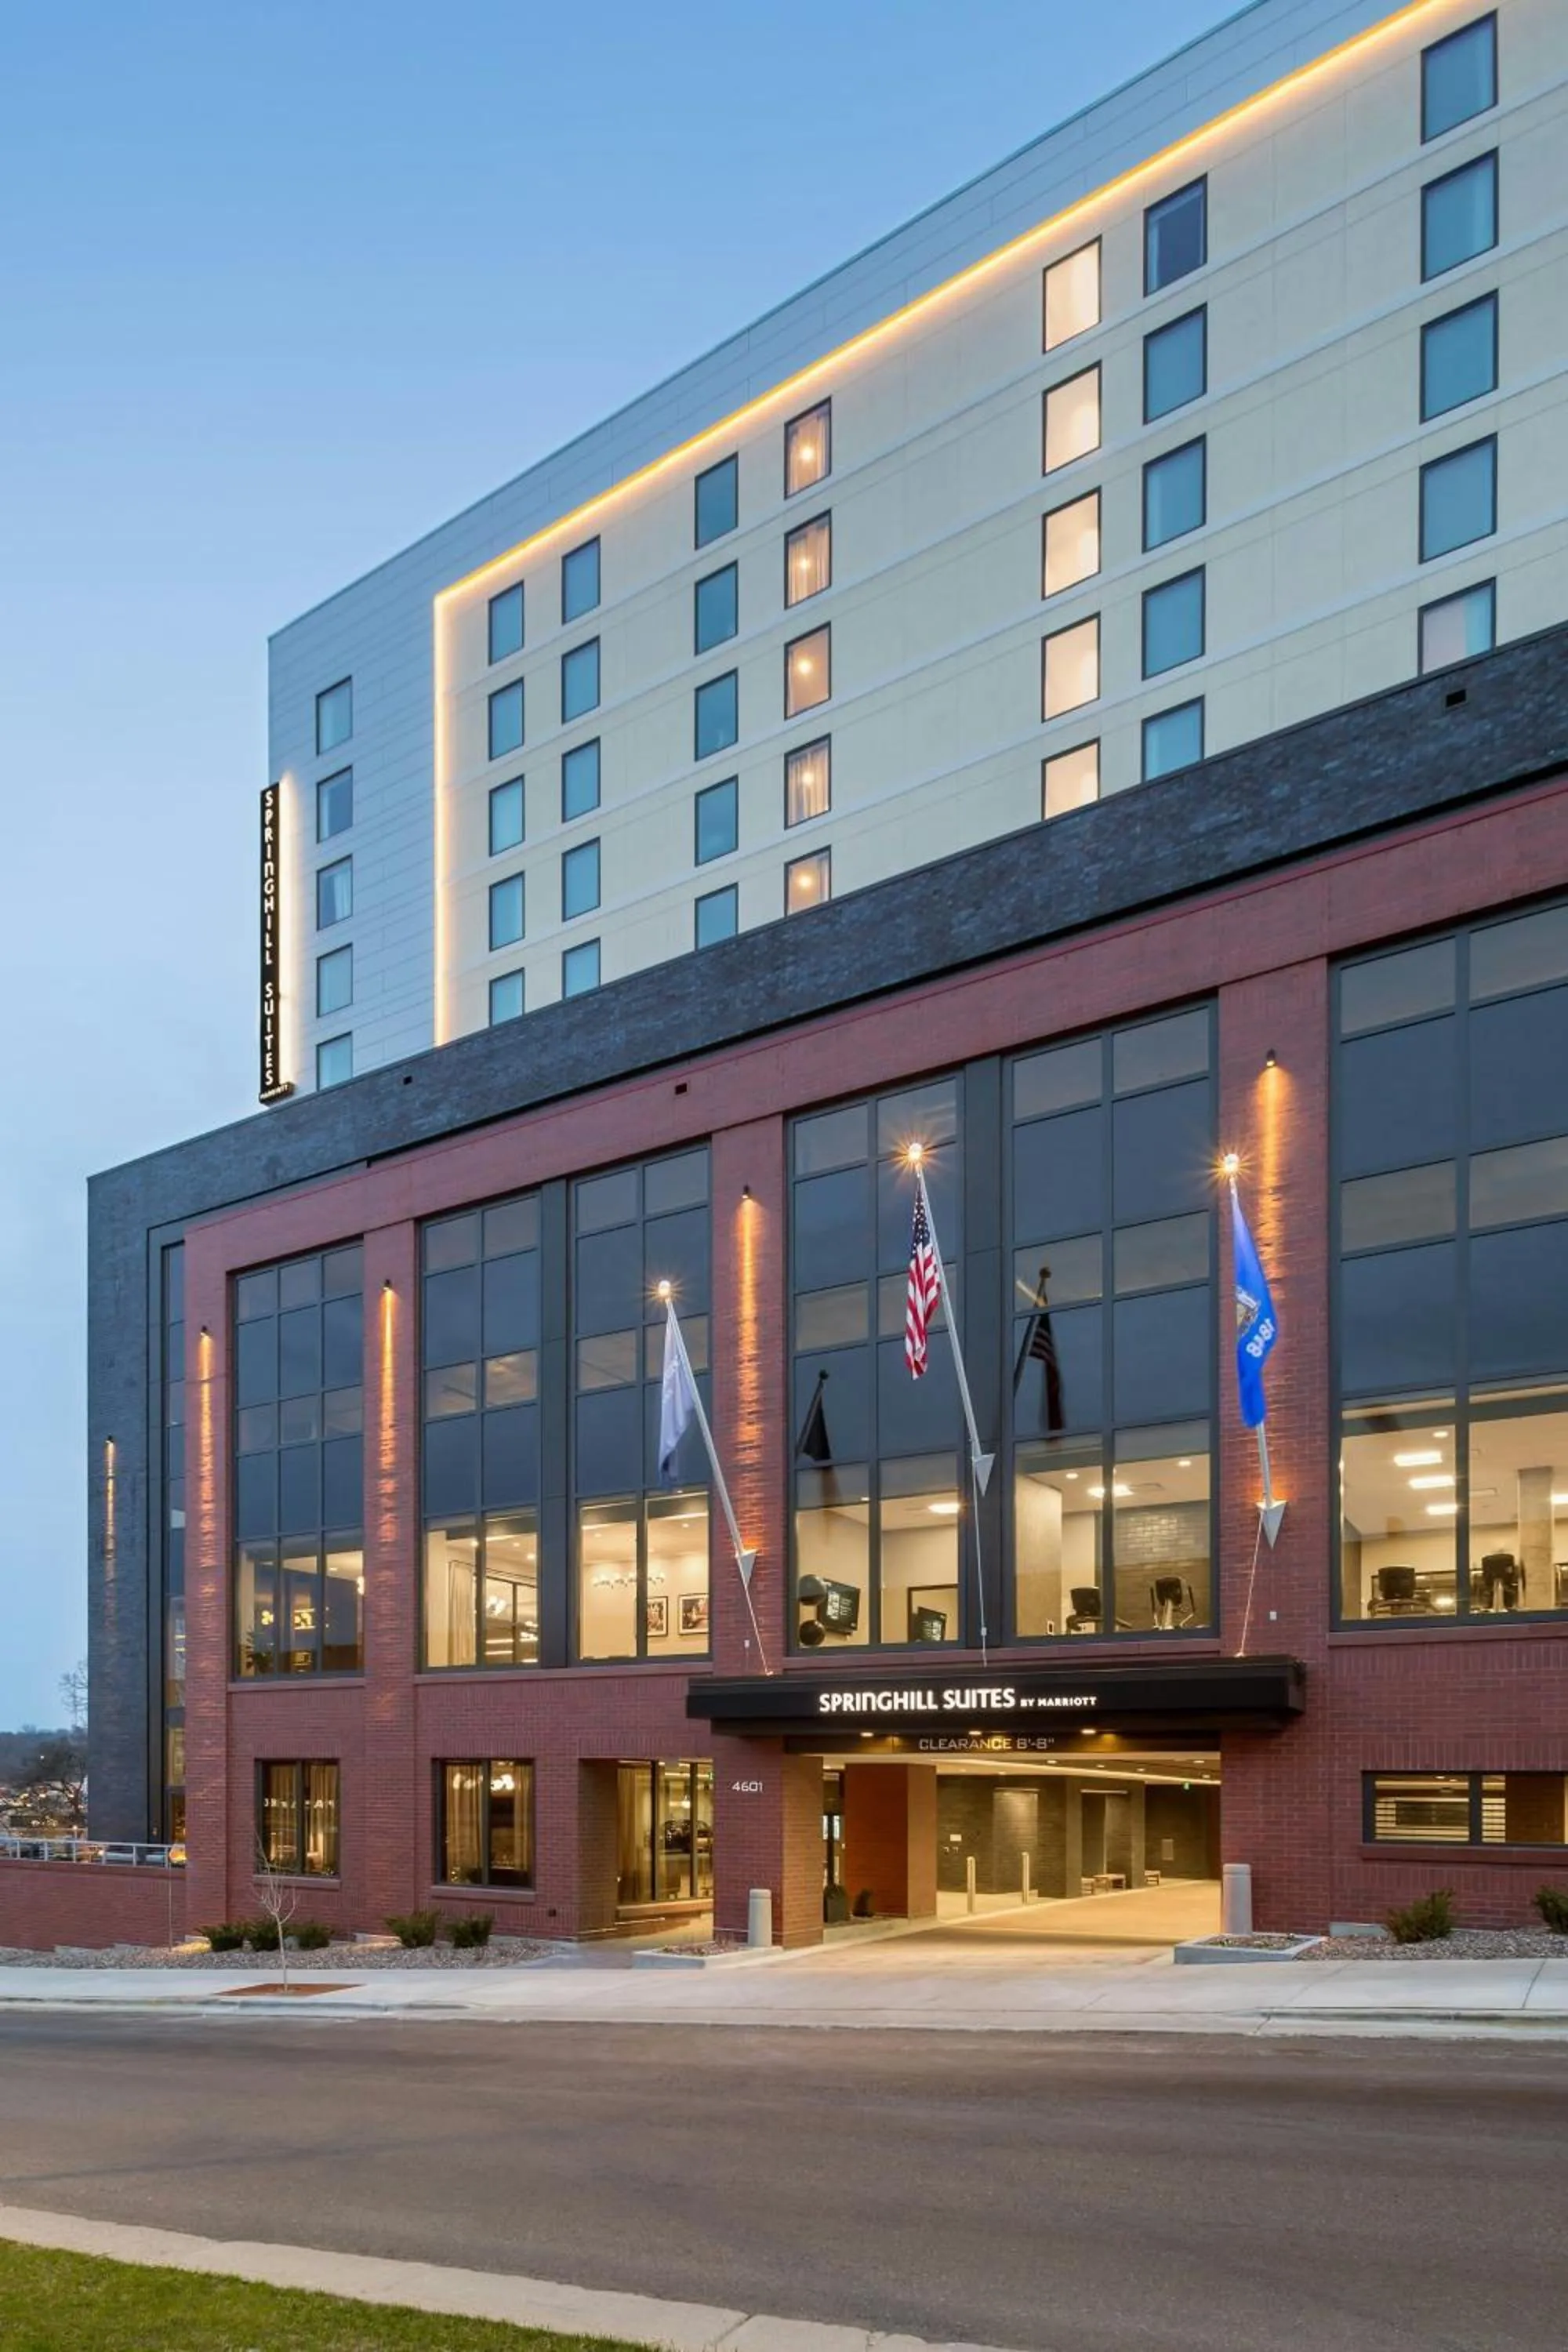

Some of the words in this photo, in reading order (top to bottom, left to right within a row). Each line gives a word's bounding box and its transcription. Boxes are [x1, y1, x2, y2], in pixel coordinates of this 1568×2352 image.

[264, 790, 274, 965] SPRINGHILL
[264, 982, 274, 1085] SUITES
[819, 1690, 938, 1711] SPRINGHILL
[943, 1688, 1014, 1708] SUITES
[1020, 1698, 1034, 1708] BY
[1037, 1697, 1097, 1707] MARRIOTT
[919, 1738, 1012, 1750] CLEARANCE
[731, 1780, 763, 1792] 4601
